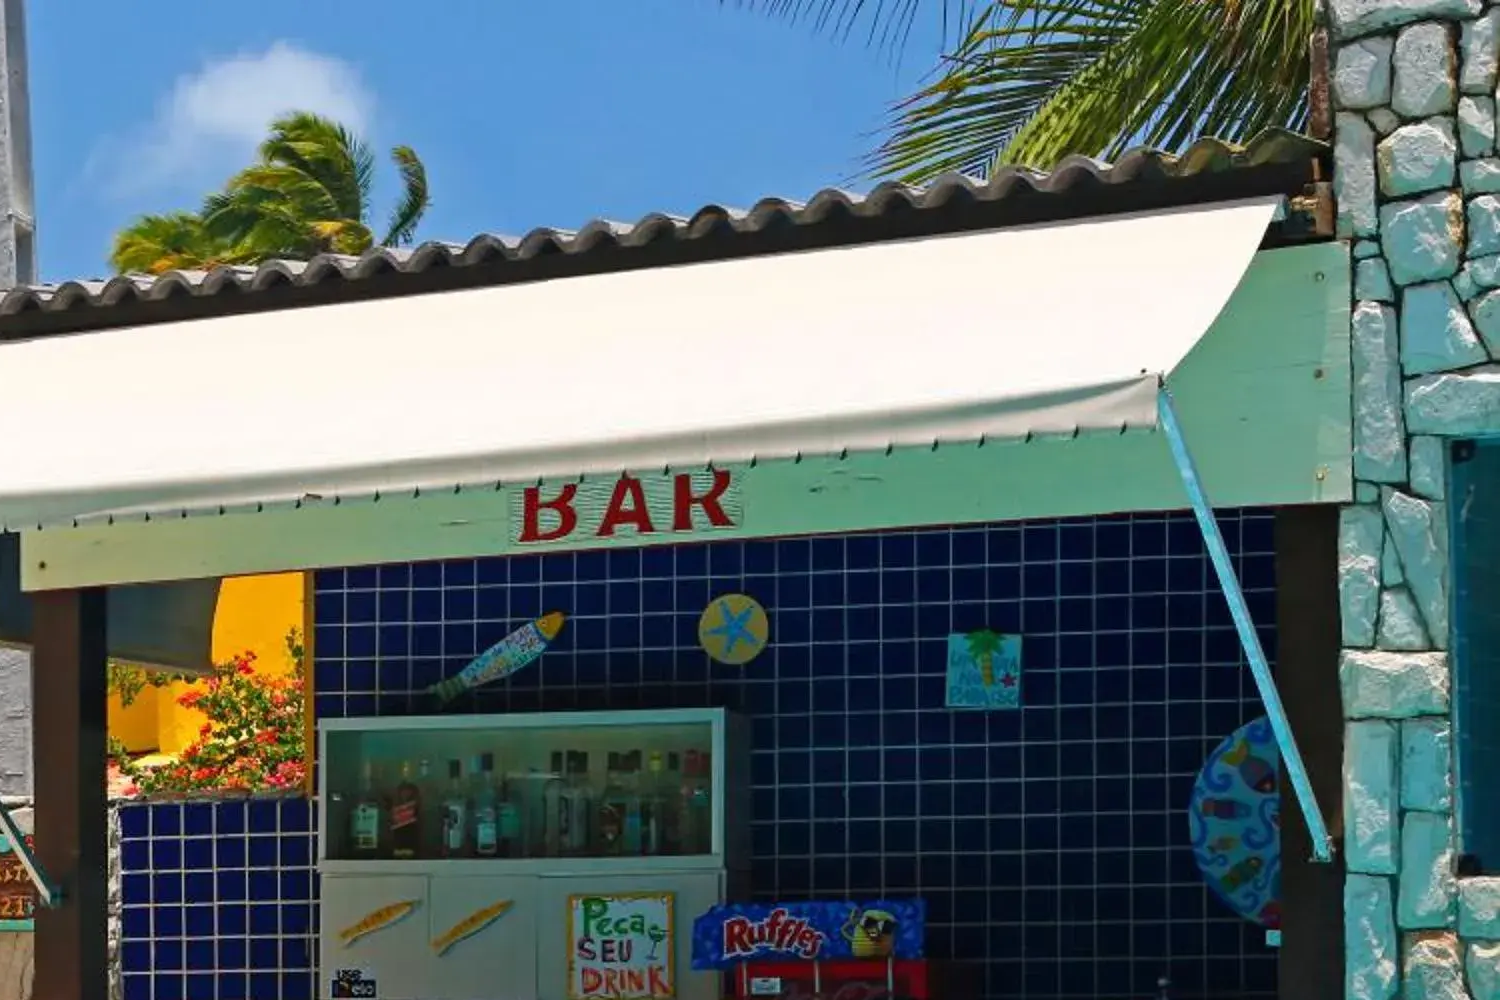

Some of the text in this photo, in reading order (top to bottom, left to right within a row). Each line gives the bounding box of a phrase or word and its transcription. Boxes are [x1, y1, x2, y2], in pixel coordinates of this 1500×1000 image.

[519, 469, 736, 543] BAR
[577, 938, 632, 963] SEU
[723, 908, 826, 959] Ruffles
[581, 964, 671, 995] DRINK
